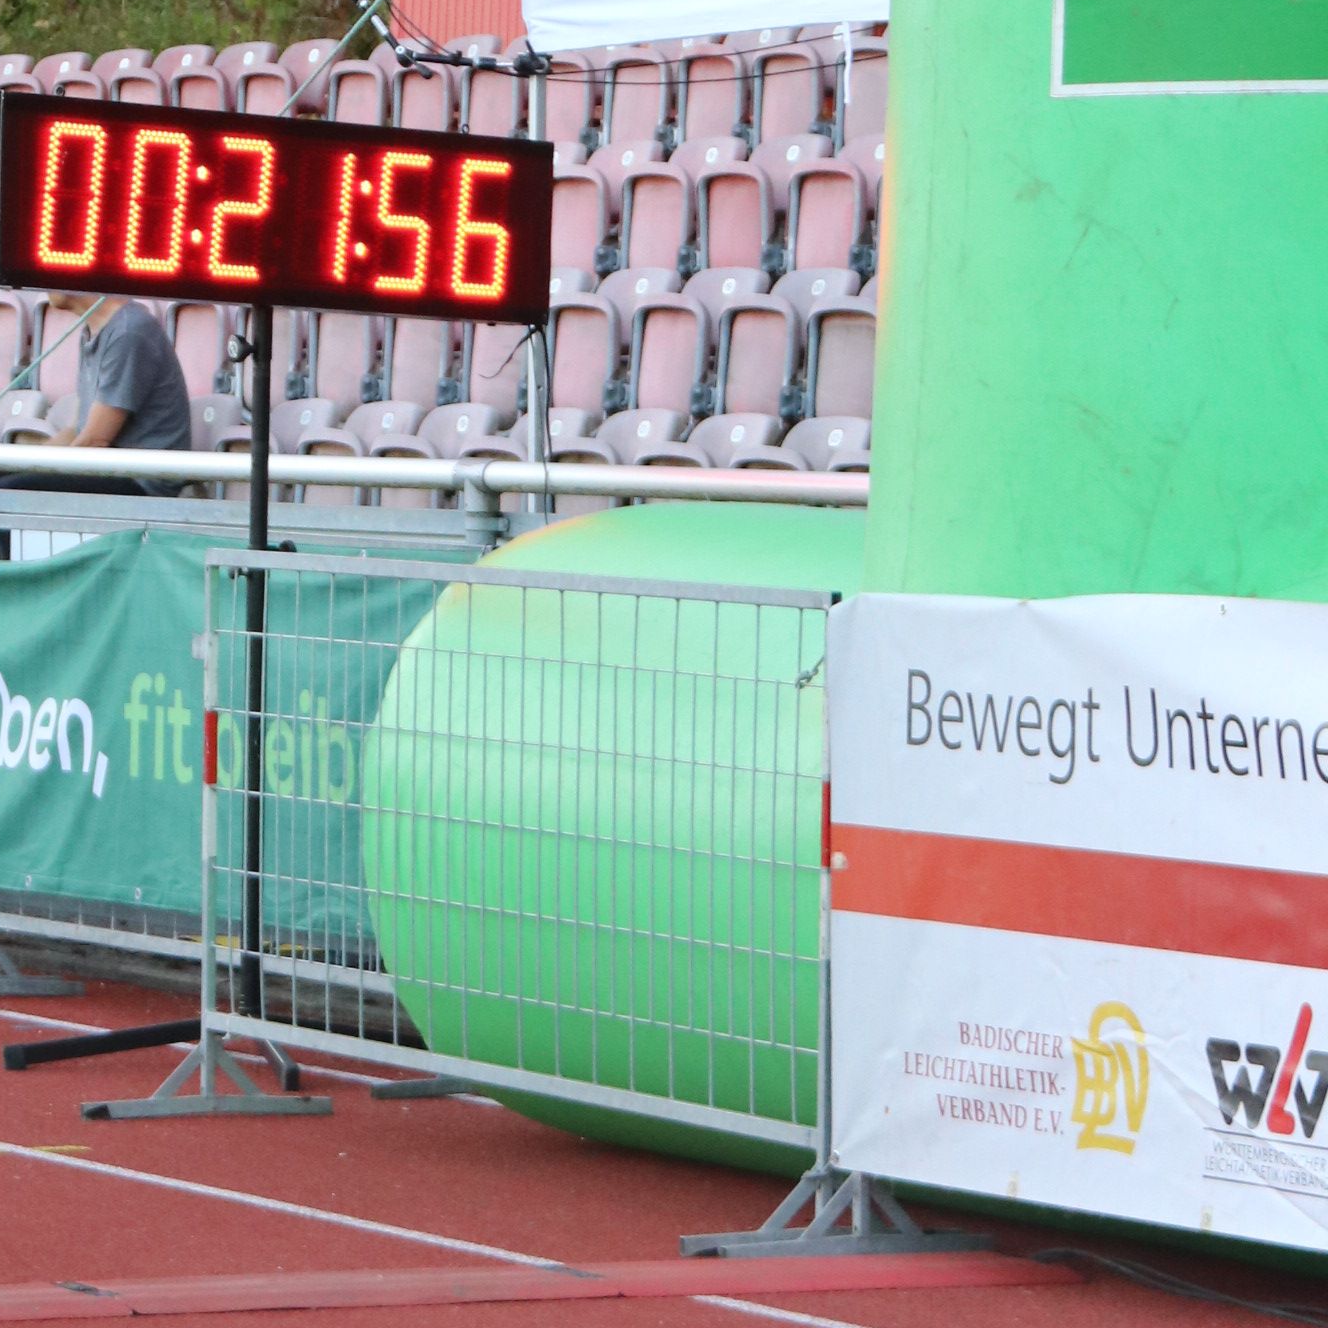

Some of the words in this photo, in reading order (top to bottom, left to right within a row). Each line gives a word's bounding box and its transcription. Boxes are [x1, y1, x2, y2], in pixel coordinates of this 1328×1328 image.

[38, 121, 512, 300] 00:21:56
[124, 672, 194, 784] fit
[905, 669, 1100, 784] Bewegt
[903, 1051, 1066, 1096] LEICHTATHLETIK-
[959, 1022, 1064, 1059] BADISCHER
[936, 1094, 1027, 1130] VERBAND
[1034, 1108, 1064, 1135] E.V.
